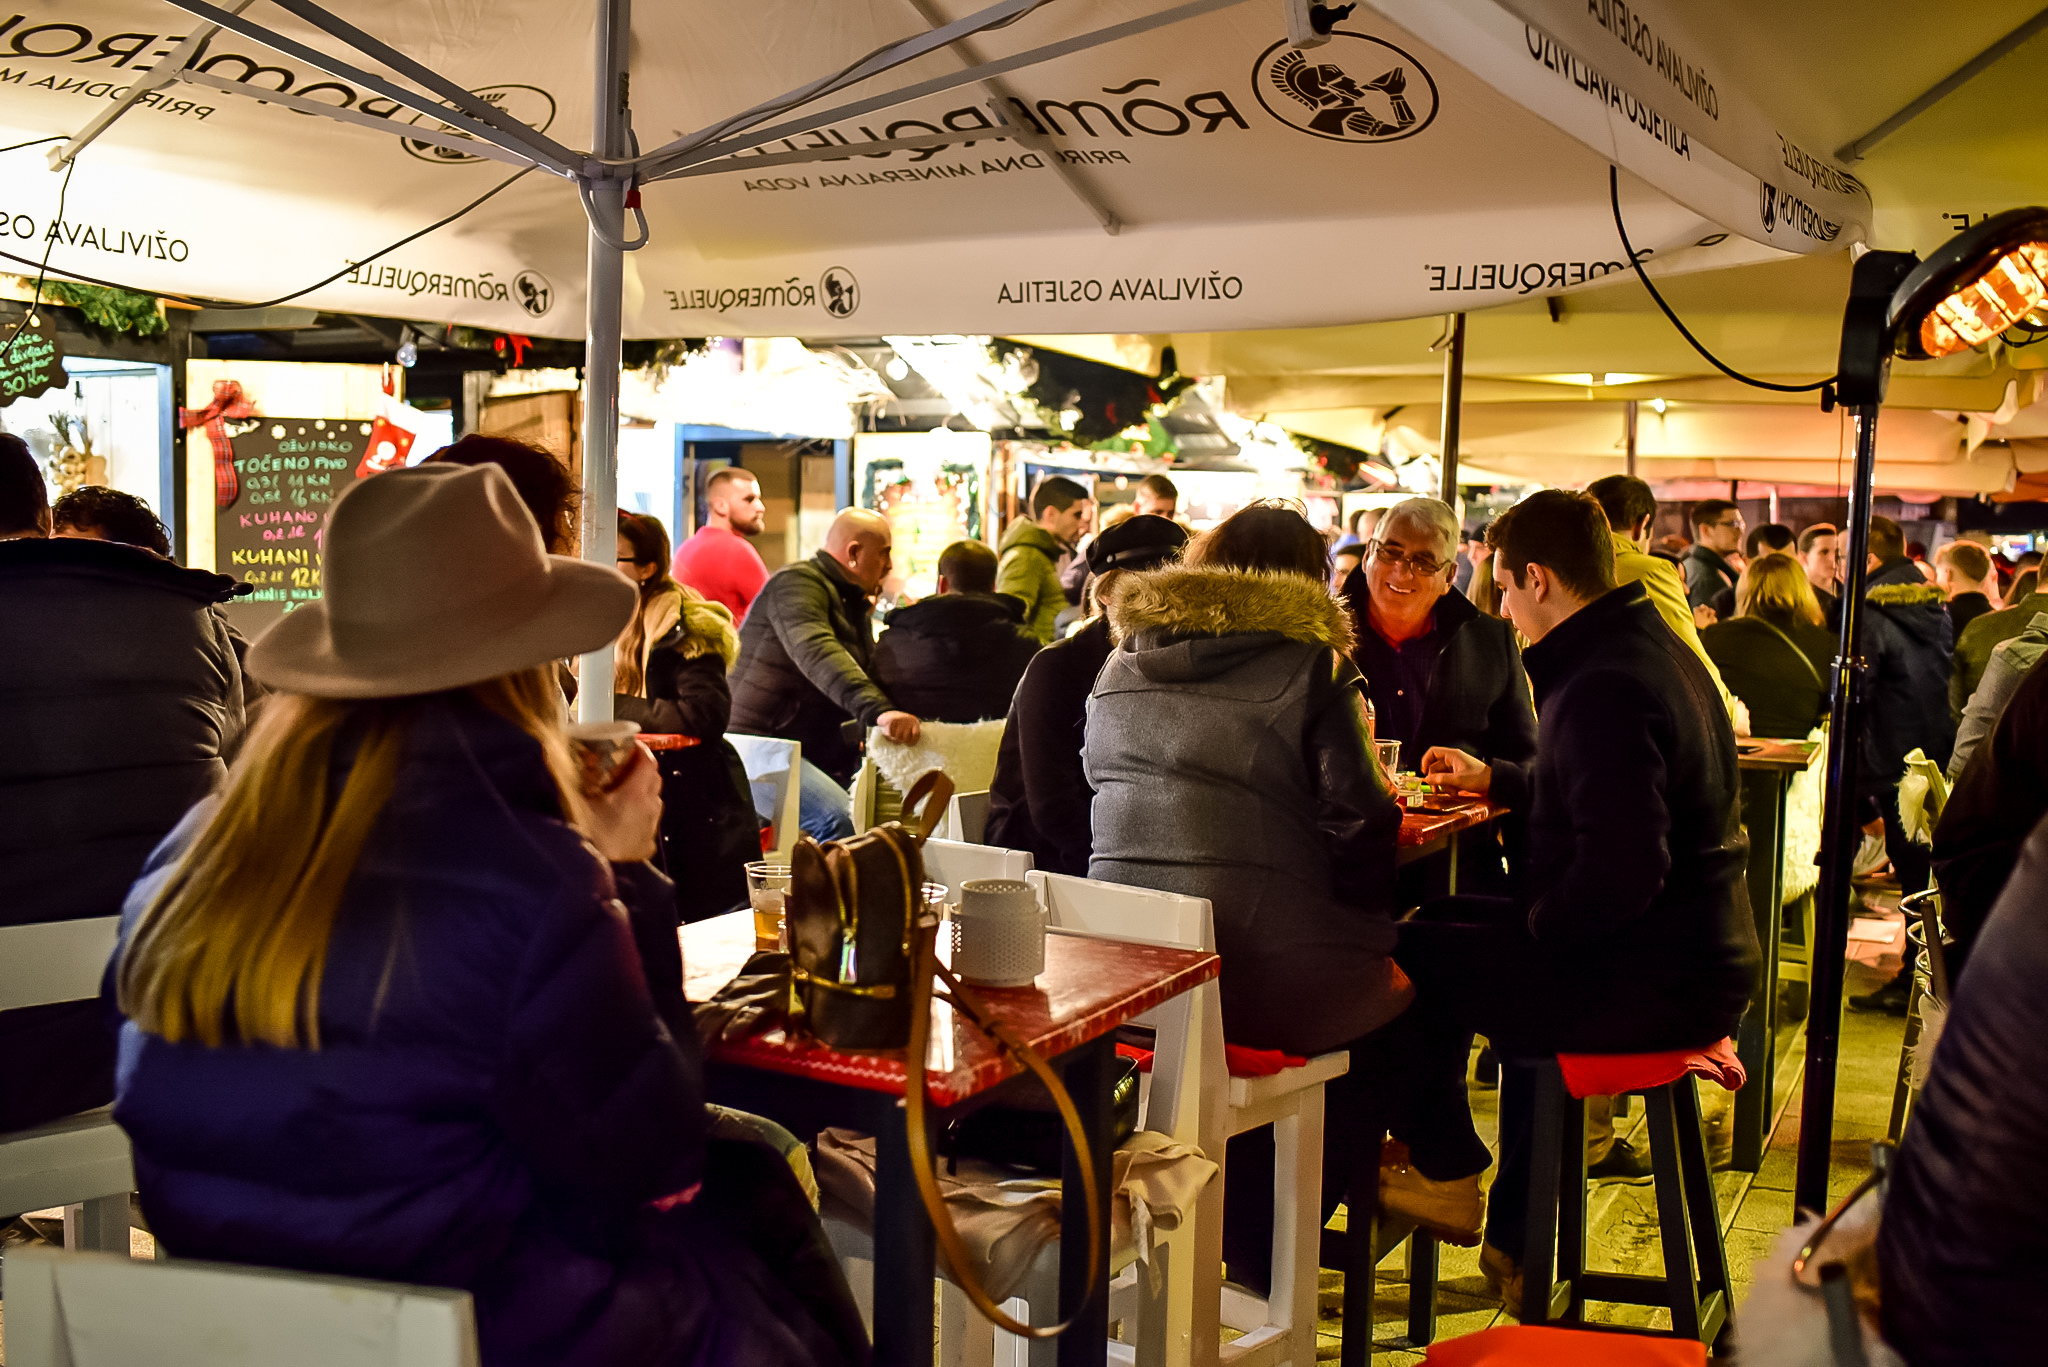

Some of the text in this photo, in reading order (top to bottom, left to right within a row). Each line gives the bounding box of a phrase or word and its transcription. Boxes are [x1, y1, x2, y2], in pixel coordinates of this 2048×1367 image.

[233, 453, 310, 474] TOČENO
[306, 472, 331, 487] KN
[239, 509, 318, 528] KUHANO
[231, 548, 309, 566] KUHANI
